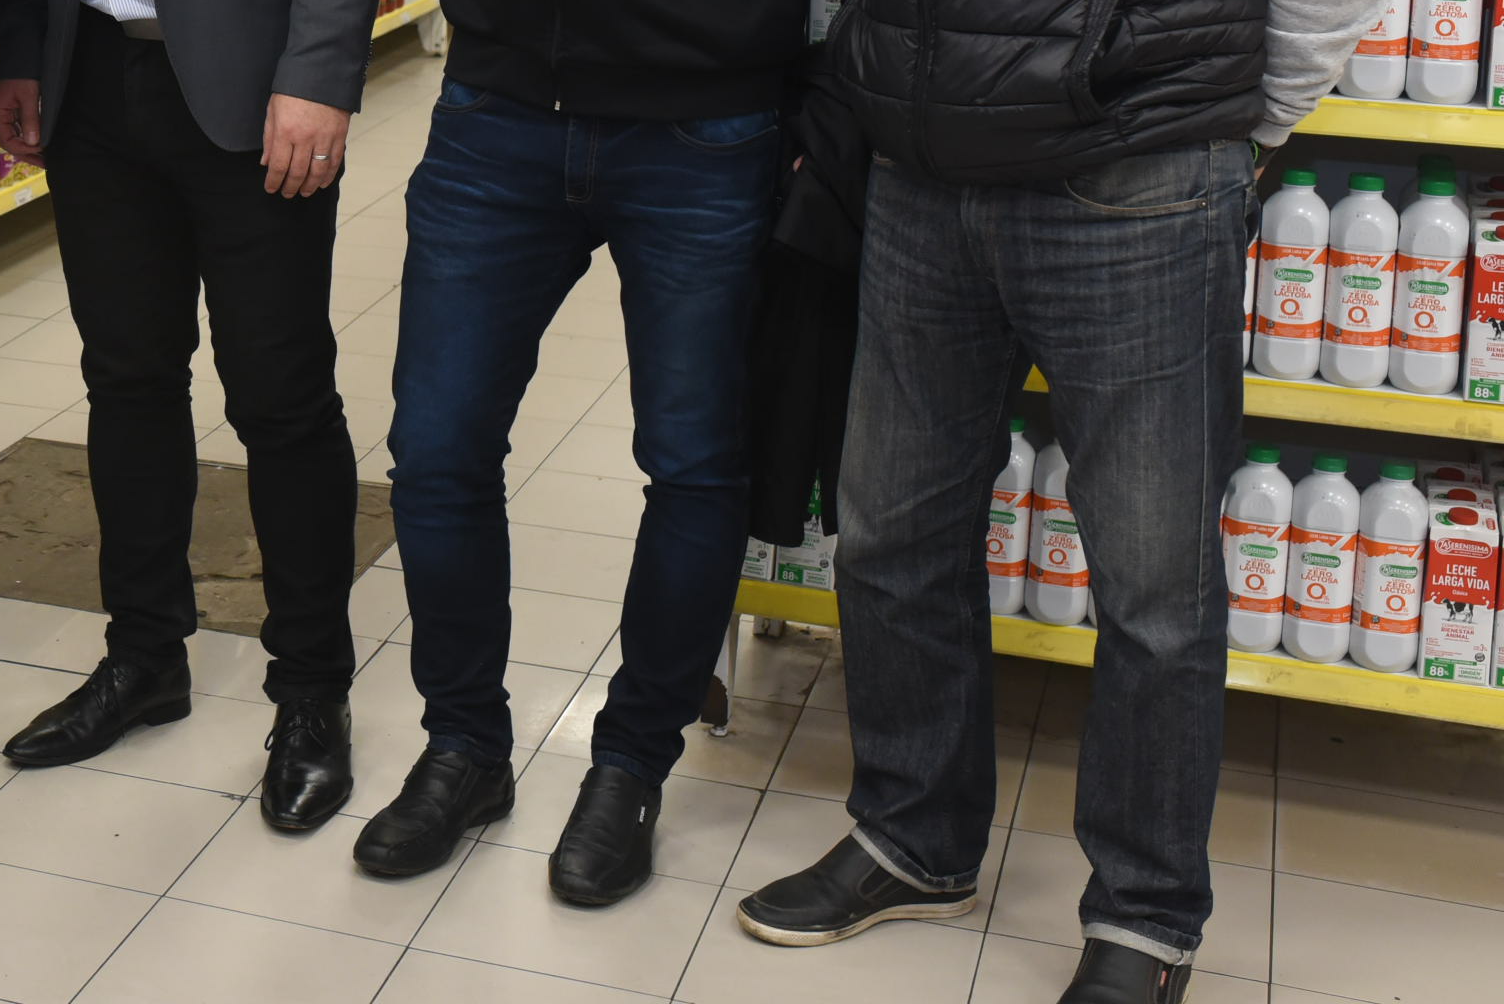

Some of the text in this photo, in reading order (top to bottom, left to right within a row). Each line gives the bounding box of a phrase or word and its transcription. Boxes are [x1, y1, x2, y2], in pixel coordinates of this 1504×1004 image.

[1478, 292, 1504, 305] LARG
[1446, 563, 1478, 577] LECHE
[1432, 574, 1491, 591] LARGA VIDA
[1441, 627, 1475, 635] BIENESTAR
